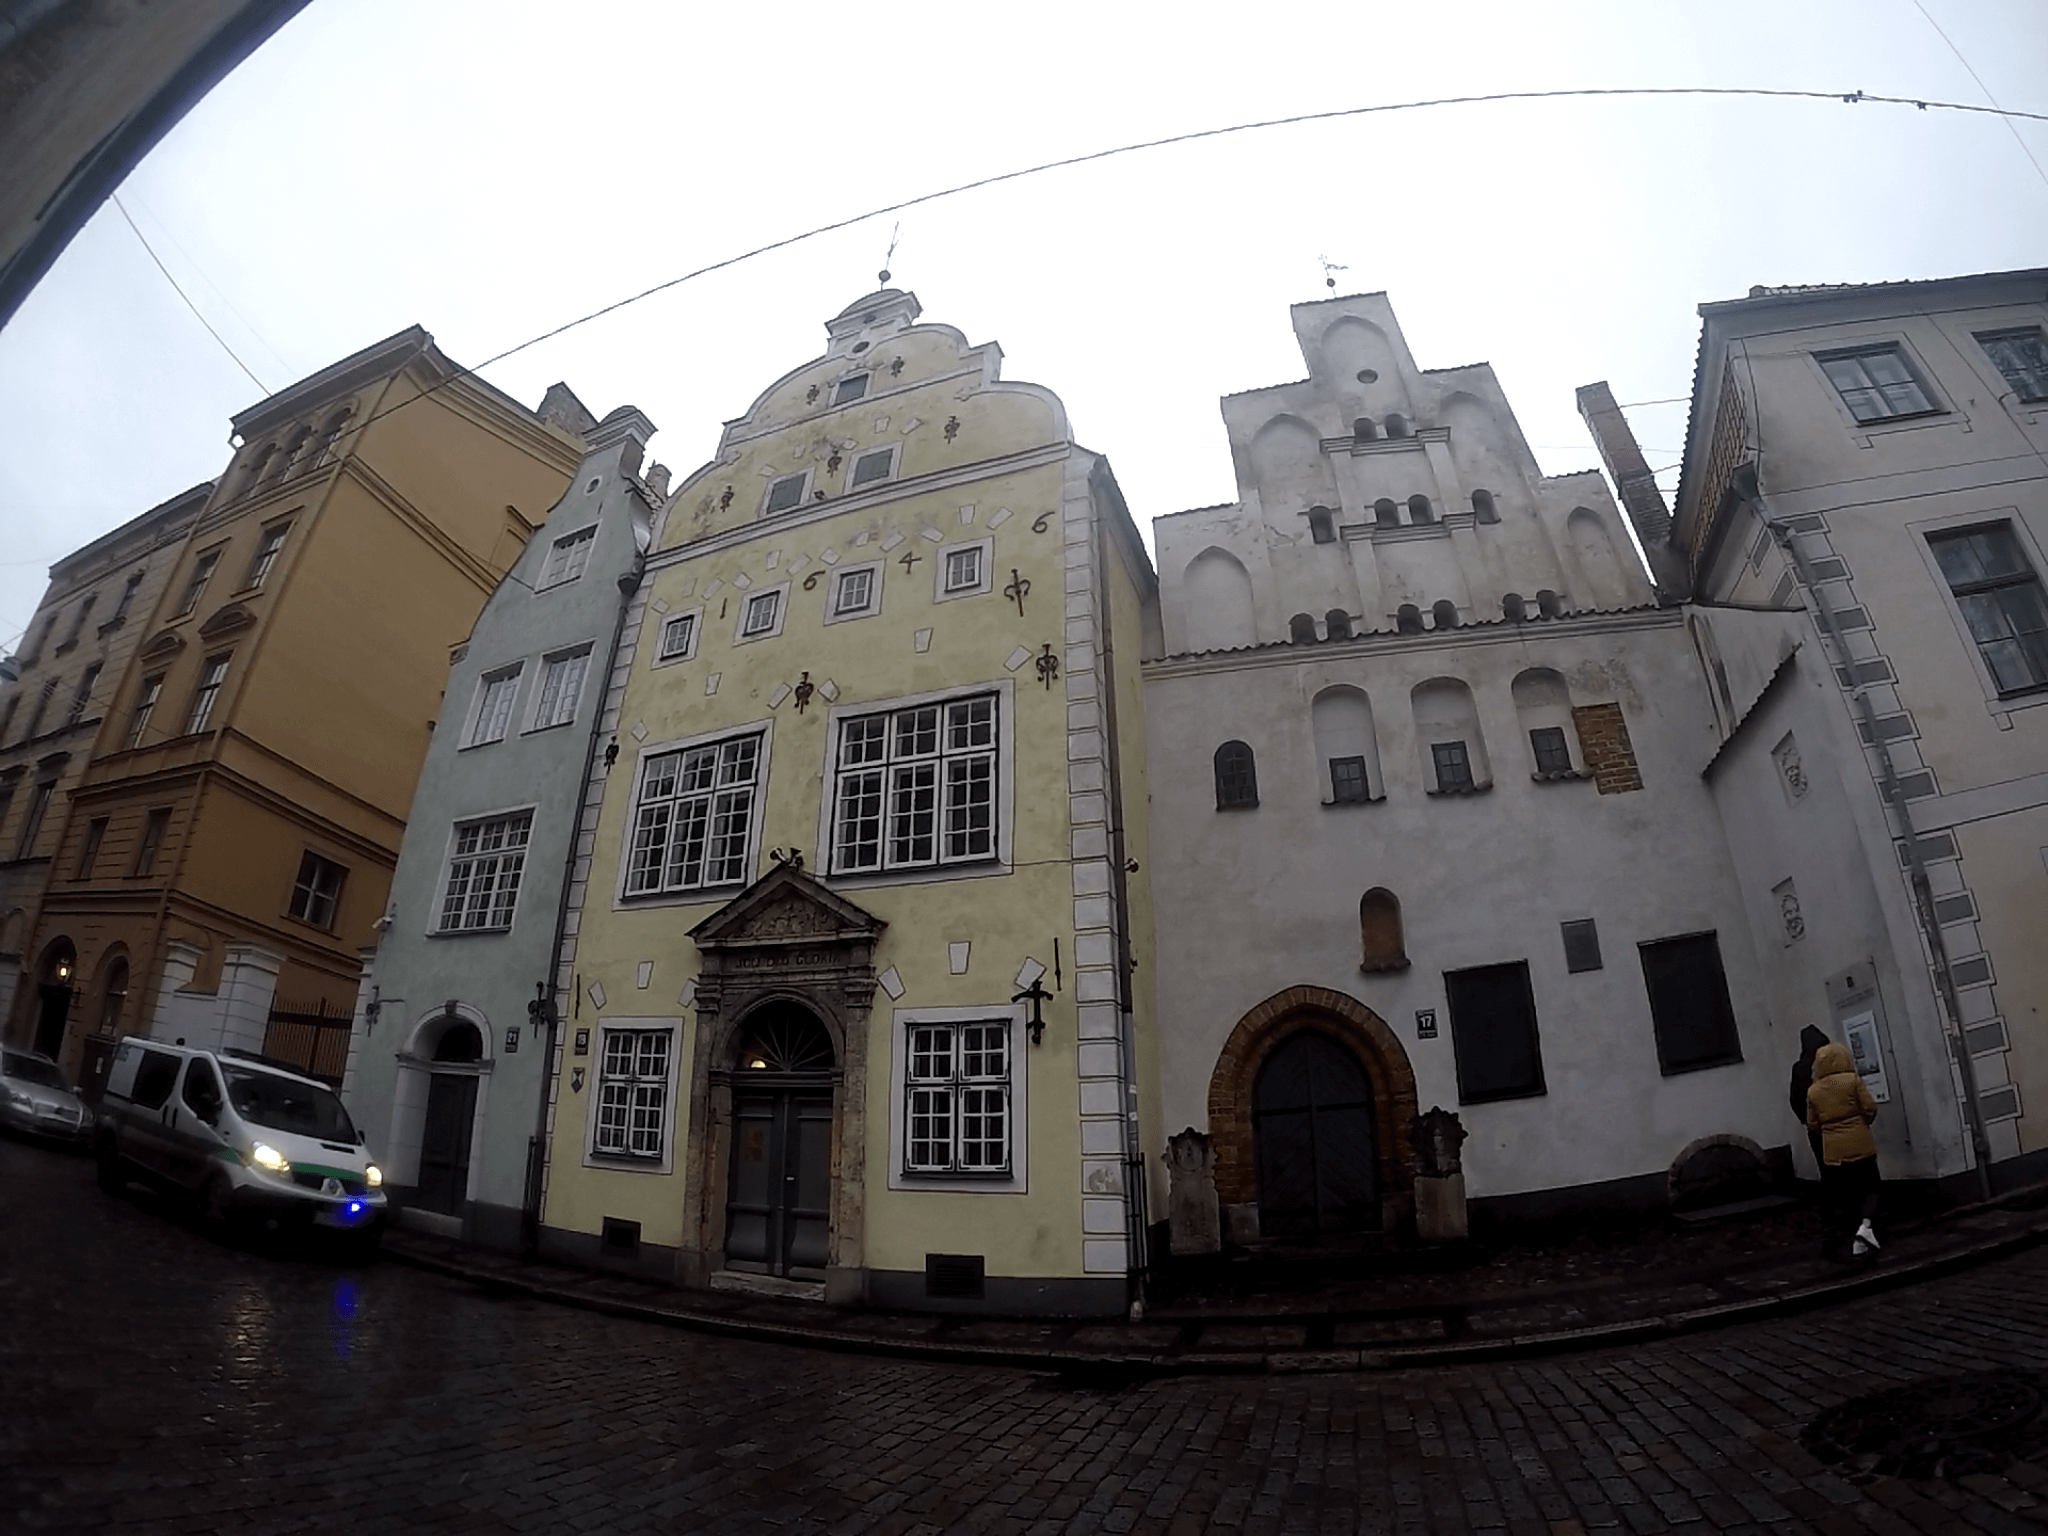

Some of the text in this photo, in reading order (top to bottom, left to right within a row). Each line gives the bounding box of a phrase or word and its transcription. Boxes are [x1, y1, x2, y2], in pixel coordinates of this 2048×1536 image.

[803, 570, 826, 591] 6
[898, 550, 922, 575] 4
[1031, 511, 1056, 534] 6
[796, 953, 841, 966] GOI
[1419, 1015, 1433, 1028] 17
[507, 1032, 517, 1043] 21
